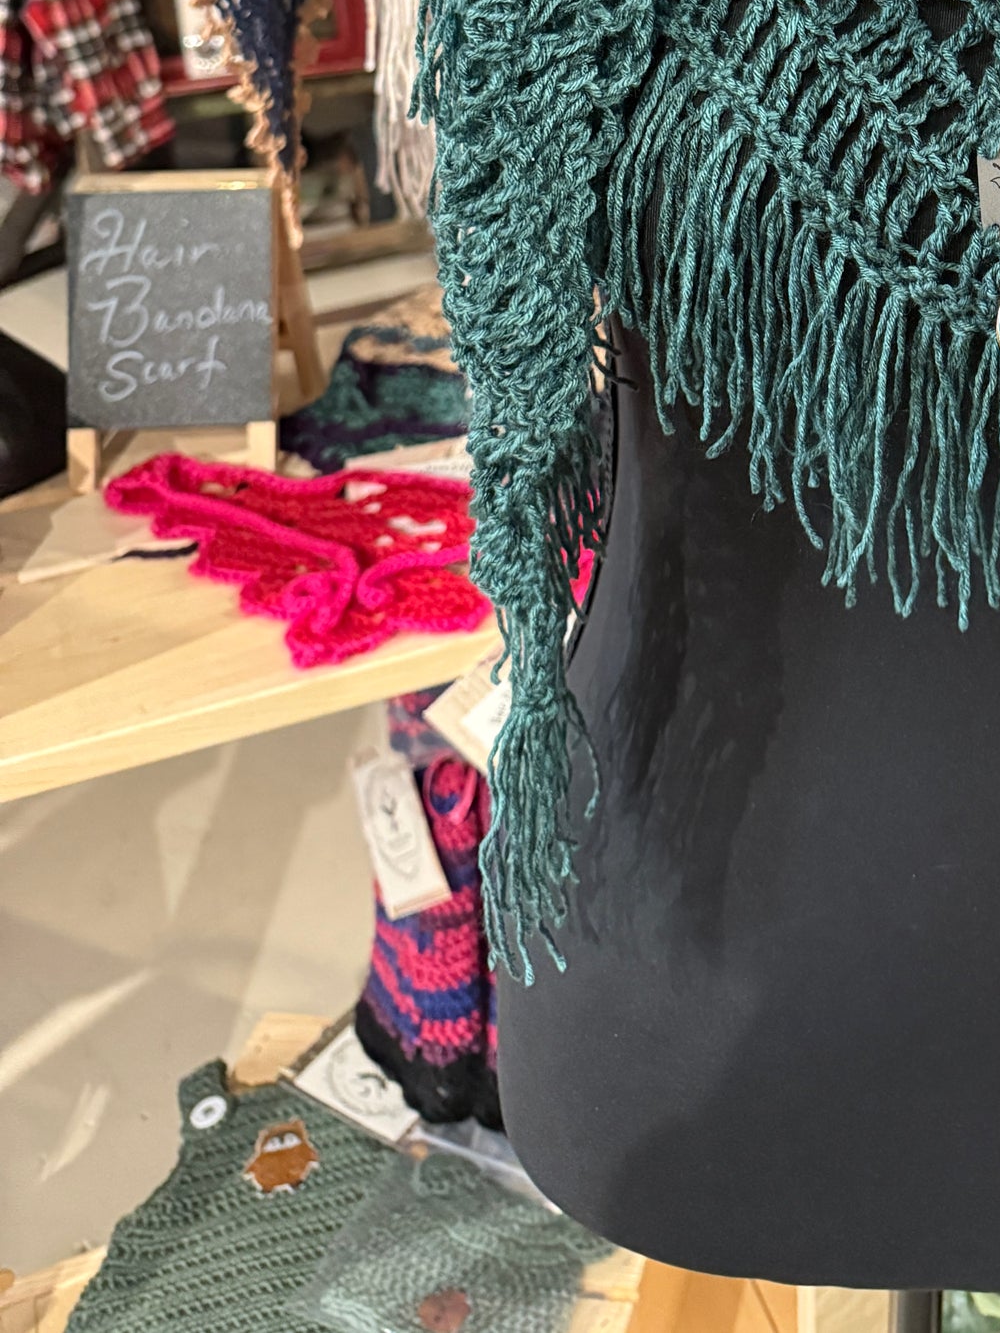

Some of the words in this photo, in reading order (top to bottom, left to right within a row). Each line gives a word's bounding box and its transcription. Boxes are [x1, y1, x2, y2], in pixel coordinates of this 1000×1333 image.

[79, 207, 219, 275] Hair
[87, 274, 274, 348] Bandana
[99, 335, 228, 403] Scarf
